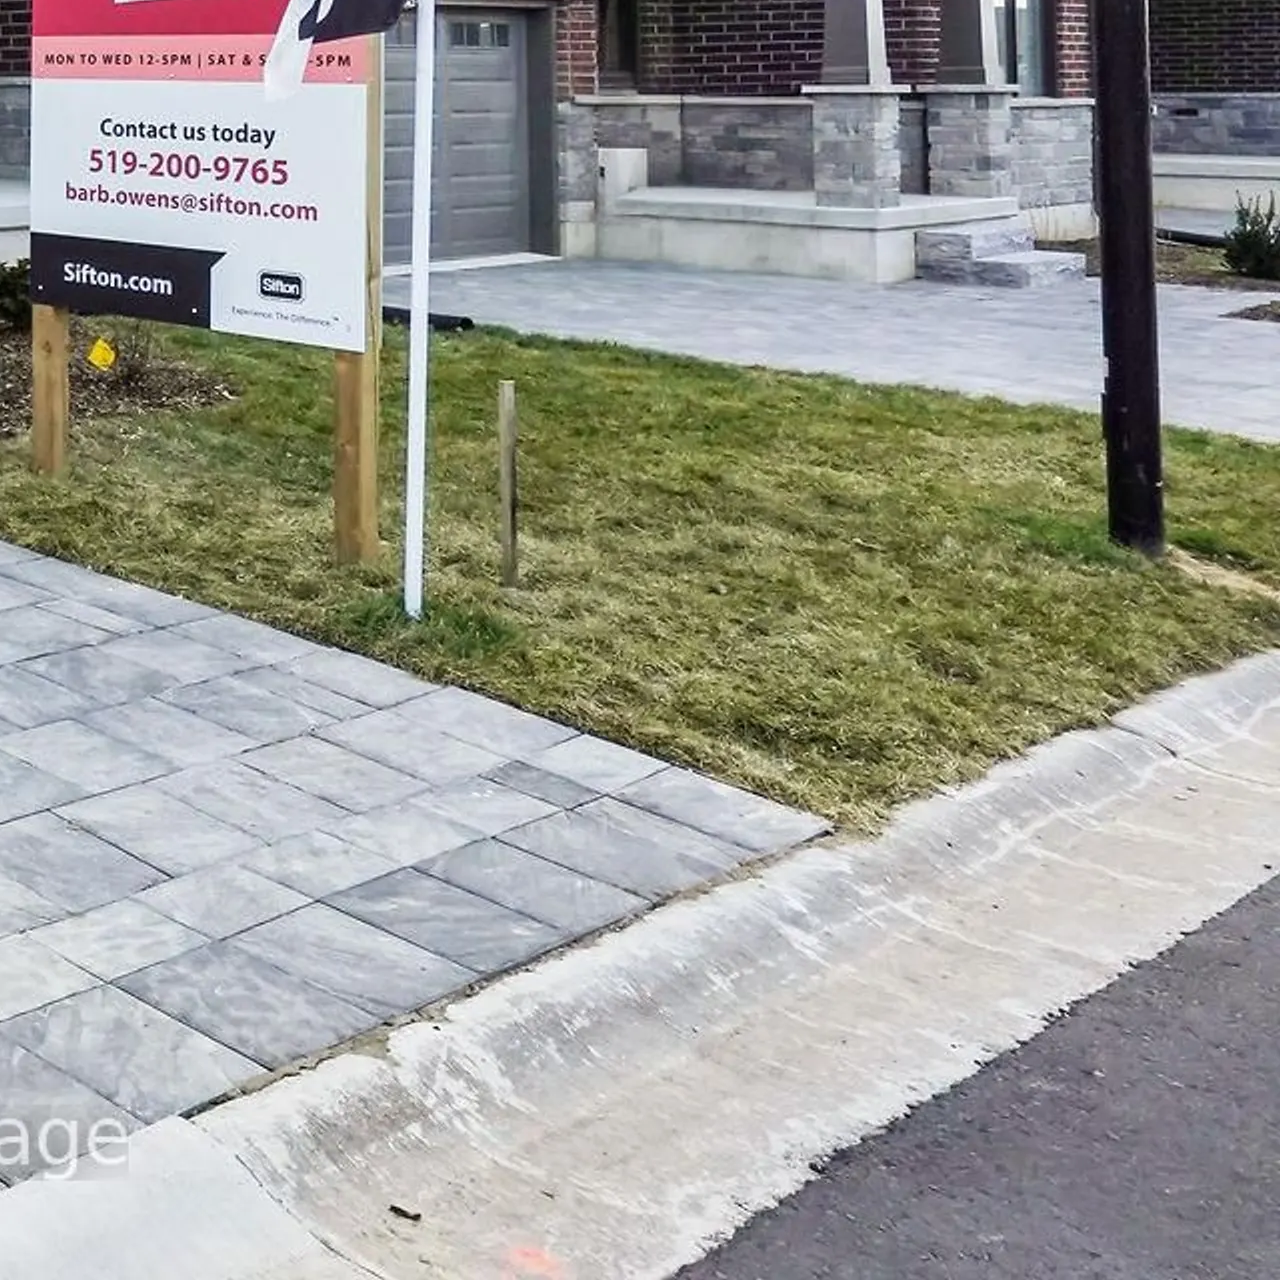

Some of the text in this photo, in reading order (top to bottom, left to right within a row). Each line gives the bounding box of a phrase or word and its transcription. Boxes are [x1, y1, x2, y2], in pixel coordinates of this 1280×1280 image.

[44, 54, 74, 65] MON
[80, 54, 97, 65] TO
[102, 54, 132, 66] WED
[139, 54, 192, 66] 12-5PM
[207, 54, 236, 67] SAT
[242, 55, 252, 66] &
[308, 54, 351, 67] -5PM
[100, 118, 276, 149] Contact us today
[89, 149, 289, 185] 519-200-9765
[65, 182, 318, 221] barb.owens@sifton.com
[63, 263, 173, 296] Sifton.com
[262, 277, 300, 296] Sifton
